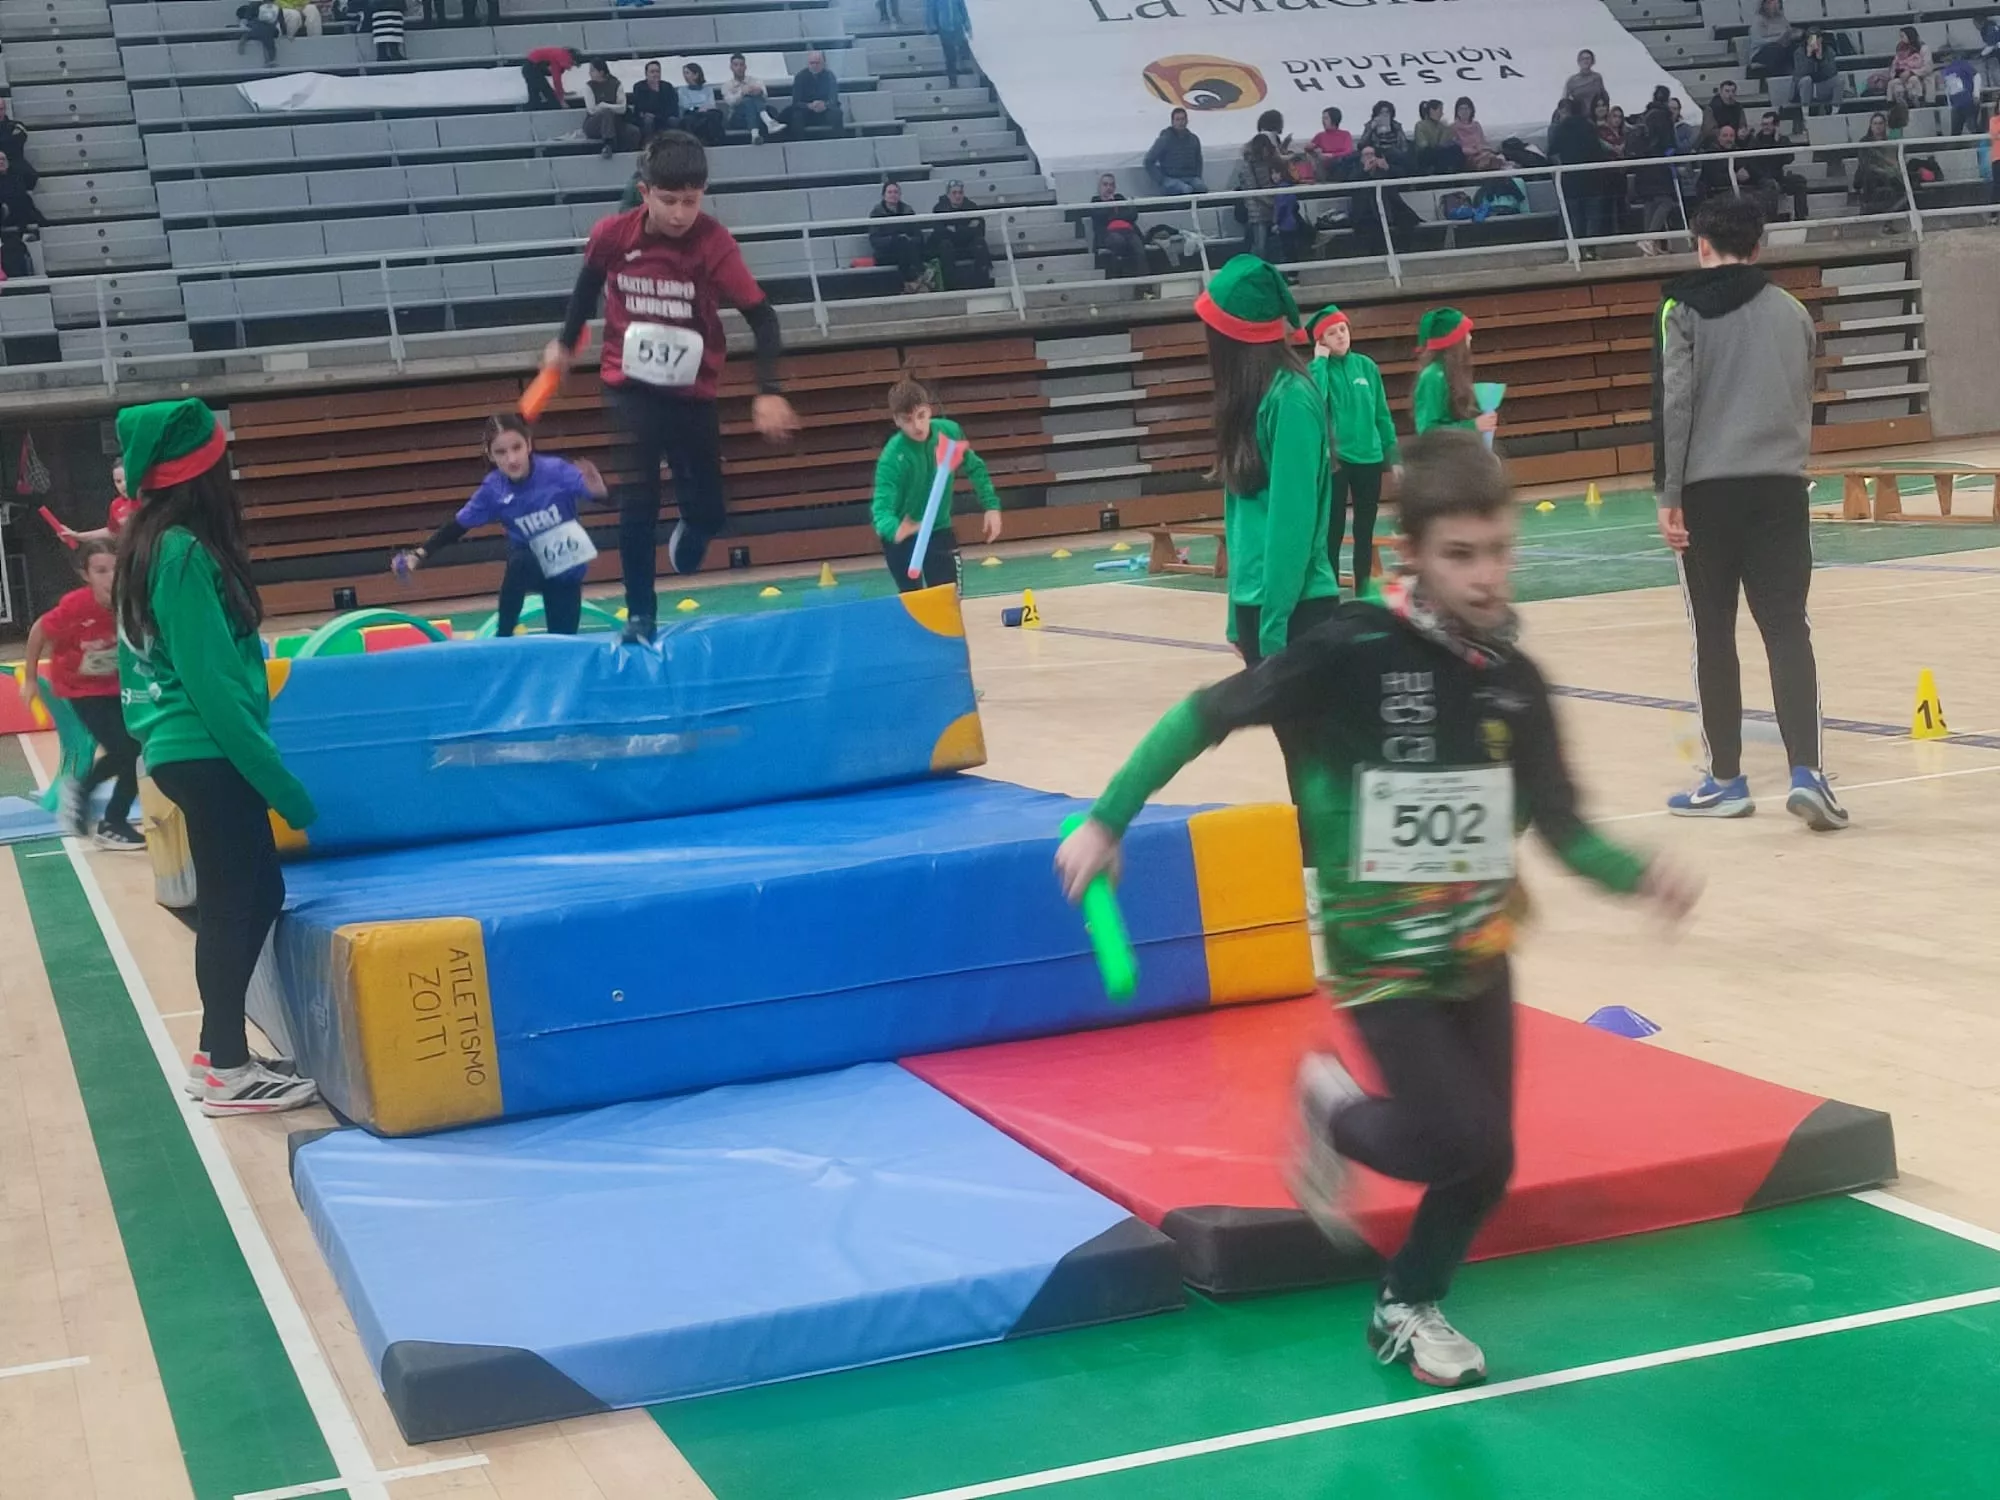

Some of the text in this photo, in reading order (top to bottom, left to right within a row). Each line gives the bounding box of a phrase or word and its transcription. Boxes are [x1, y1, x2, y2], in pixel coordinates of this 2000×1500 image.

[1281, 46, 1514, 75] DIPUTACIÓN
[1293, 64, 1526, 93] HUESCA
[638, 339, 689, 368] 537
[543, 536, 579, 562] 626
[1391, 803, 1488, 847] 502
